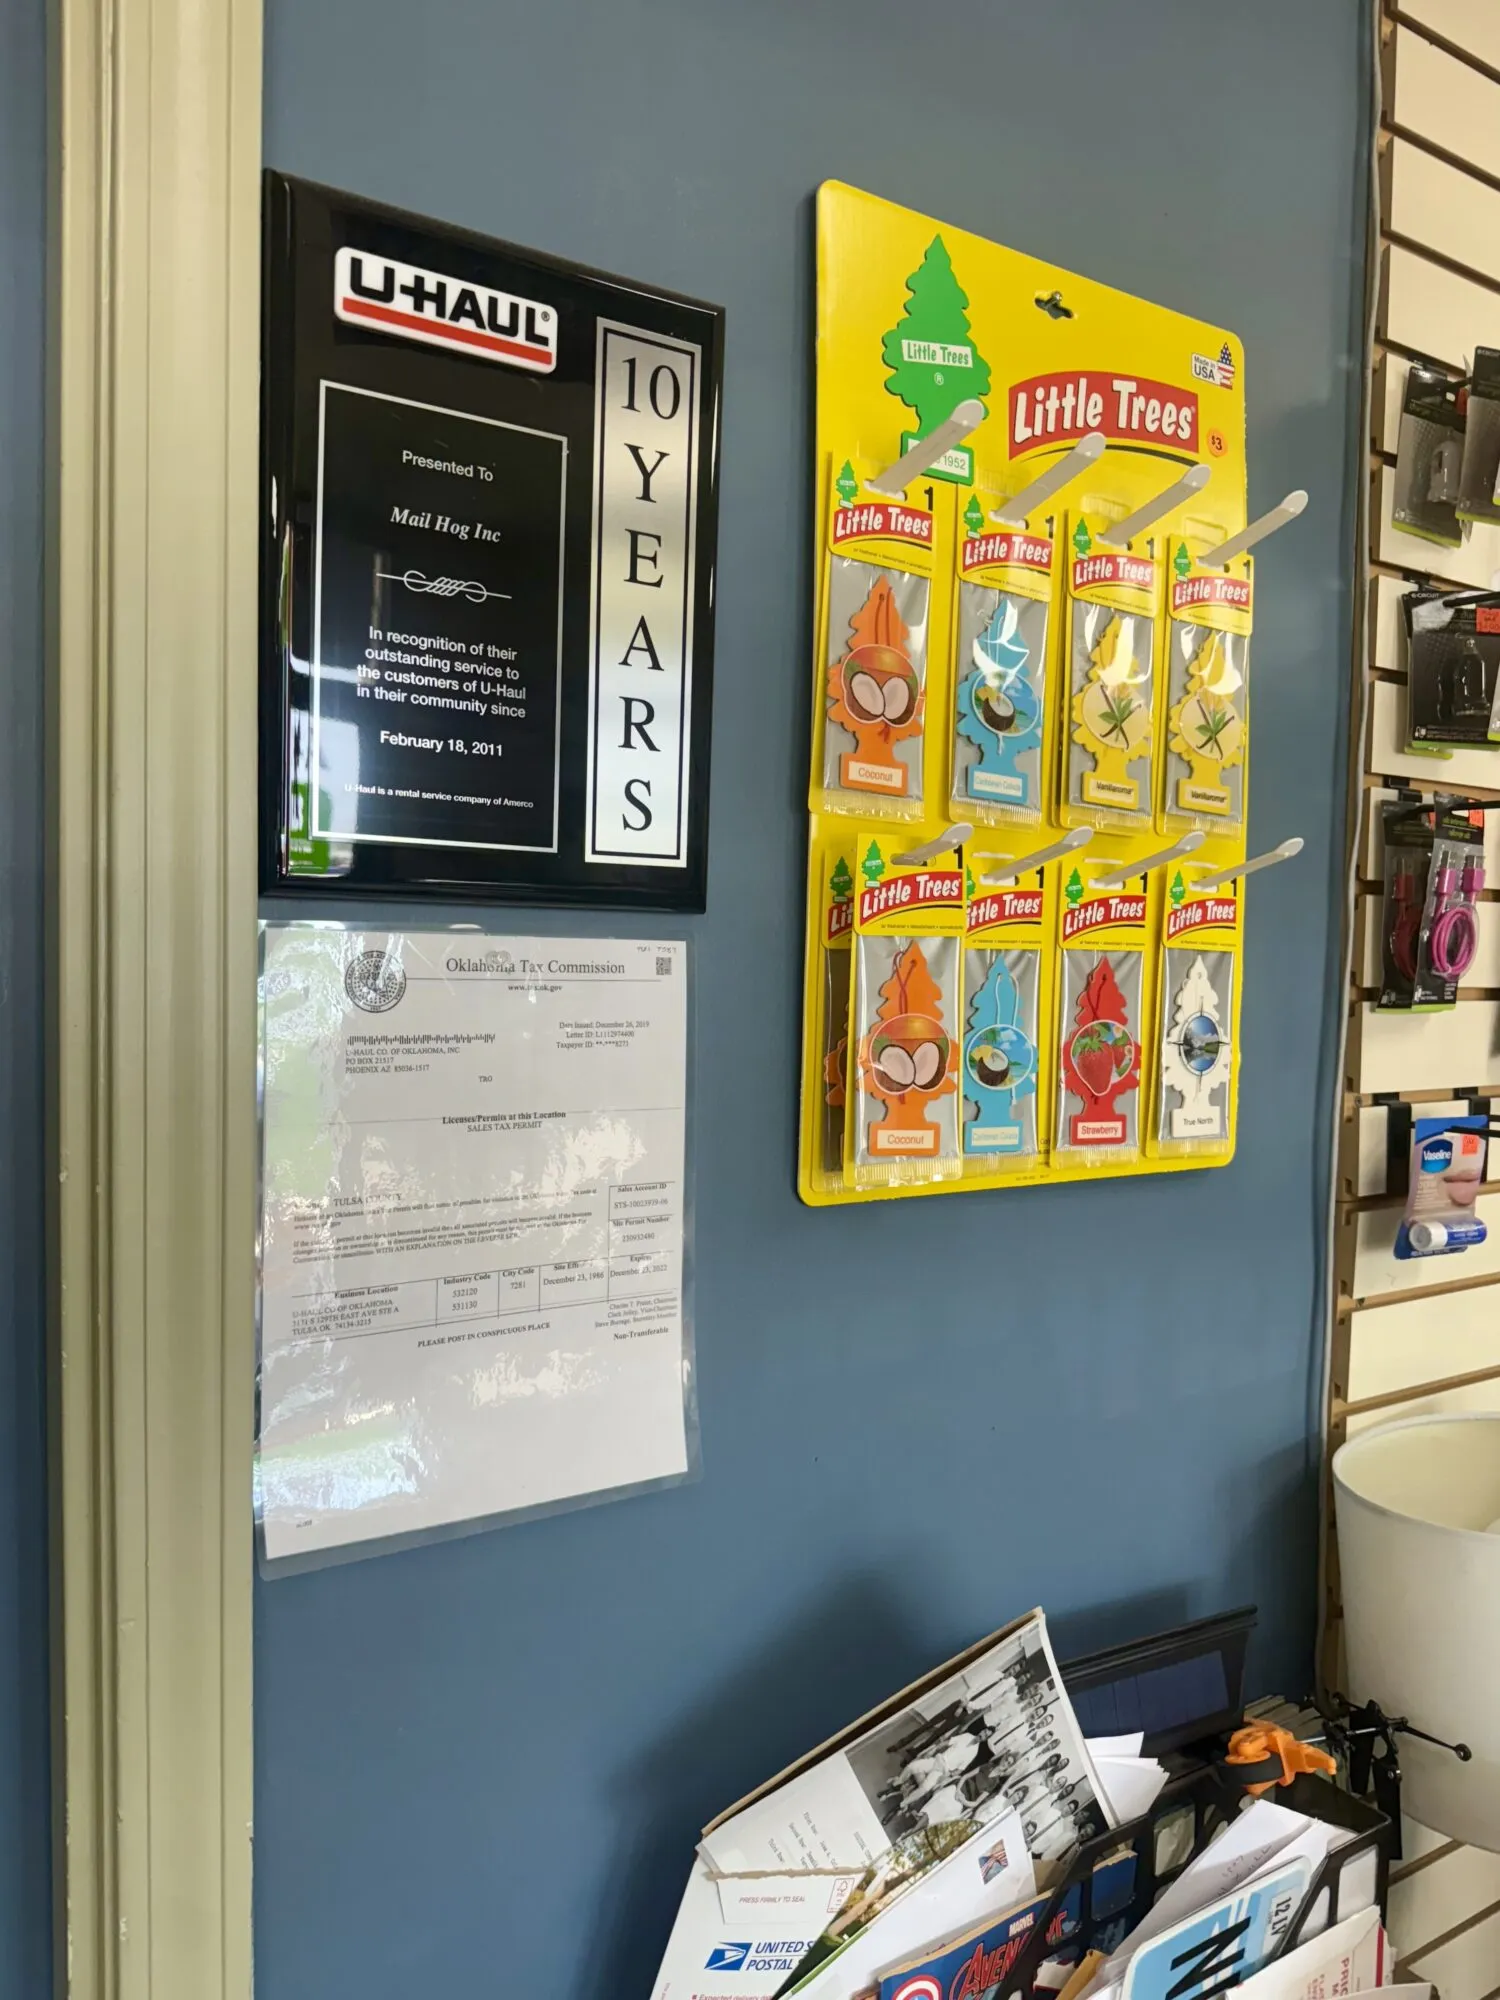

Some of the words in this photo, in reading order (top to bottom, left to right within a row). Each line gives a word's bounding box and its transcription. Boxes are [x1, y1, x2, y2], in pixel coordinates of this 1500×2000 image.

[907, 342, 937, 361] Little
[940, 347, 969, 365] Trees
[1194, 363, 1215, 381] USA
[621, 357, 680, 419] 10
[1015, 377, 1103, 443] Little
[1113, 379, 1192, 440] Trees
[402, 450, 473, 477] Presented
[478, 465, 493, 481] To
[944, 455, 966, 470] 1952
[924, 486, 933, 511] 1
[391, 506, 430, 529] Mail
[435, 516, 470, 540] Hog
[475, 523, 500, 542] Inc
[836, 507, 882, 538] Little
[888, 507, 929, 537] Trees
[1045, 516, 1054, 539] 1
[965, 539, 1007, 566] Little
[1012, 536, 1049, 563] Trees
[1147, 538, 1154, 559] 1
[1075, 558, 1112, 585] Little
[1117, 557, 1152, 581] Trees
[1175, 580, 1209, 605] Little
[1214, 579, 1248, 602] Trees
[369, 626, 382, 640] In
[387, 631, 466, 653] recognition
[470, 644, 485, 655] of
[487, 645, 518, 661] their
[365, 648, 450, 673] outstanding
[454, 660, 502, 678] service
[506, 667, 519, 680] to
[356, 665, 380, 679] the
[385, 670, 459, 690] customers
[463, 681, 477, 693] of
[481, 682, 526, 700] U-Haul
[357, 684, 370, 697] in
[374, 686, 407, 702] their
[411, 694, 487, 716] community
[491, 702, 526, 718] since
[380, 730, 443, 752] February
[448, 739, 468, 755] 18,
[472, 742, 502, 756] 2011
[858, 767, 893, 782] Coconut
[344, 784, 375, 794] U-Haul
[378, 787, 385, 795] is
[395, 787, 420, 798] rental
[422, 791, 452, 801] service
[454, 793, 491, 806] company
[503, 798, 534, 808] Amerco
[953, 844, 962, 869] 1
[1036, 866, 1044, 888] 1
[1140, 872, 1148, 894] 1
[863, 885, 911, 919] Little
[916, 875, 960, 899] Trees
[967, 898, 998, 928] ittle
[1003, 894, 1040, 916] Trees
[1065, 903, 1104, 935] Little
[1109, 898, 1144, 919] Trees
[1169, 906, 1202, 934] Little
[1206, 900, 1234, 920] Trees
[520, 960, 543, 973] Tax
[548, 960, 625, 974] Commission
[556, 1041, 583, 1049] Taxpayer
[442, 1113, 506, 1125] Licenses/Permits
[518, 1112, 531, 1120] this
[533, 1111, 566, 1119] Location
[467, 1123, 492, 1133] SALES
[494, 1122, 511, 1131] TAX
[512, 1121, 543, 1130] PERMIT
[1183, 1118, 1196, 1126] True
[1197, 1116, 1213, 1125] North
[888, 1134, 924, 1145] Coconut
[1081, 1124, 1119, 1136] Strawberry
[1423, 1150, 1451, 1160] Vaseline
[333, 1198, 363, 1206] TULSA
[406, 1240, 452, 1251] EXPLANATION
[502, 1269, 516, 1278] City
[517, 1268, 534, 1276] Code
[543, 1275, 575, 1286] December
[589, 1271, 604, 1280] 1986
[652, 1264, 668, 1272] 2022
[443, 1275, 471, 1285] Industry
[474, 1273, 491, 1282] Code
[367, 1286, 398, 1295] Location
[452, 1288, 478, 1298] 532120
[337, 1304, 348, 1313] OF
[349, 1300, 393, 1311] OKLAHOMA
[341, 1311, 360, 1320] EAST
[361, 1309, 375, 1318] AVE
[376, 1308, 392, 1317] STE
[452, 1301, 477, 1311] 531130
[292, 1326, 318, 1336] TULSA
[417, 1336, 446, 1348] PLEASE
[447, 1333, 465, 1343] POST
[468, 1332, 475, 1340] IN
[477, 1325, 526, 1339] CONSPICUOUS
[528, 1322, 550, 1333] PLACE
[614, 1327, 668, 1340] Non-Transferable
[1009, 1912, 1034, 1936] MARVEL
[754, 1941, 804, 1954] UNITED
[746, 1959, 794, 1971] POSTAL
